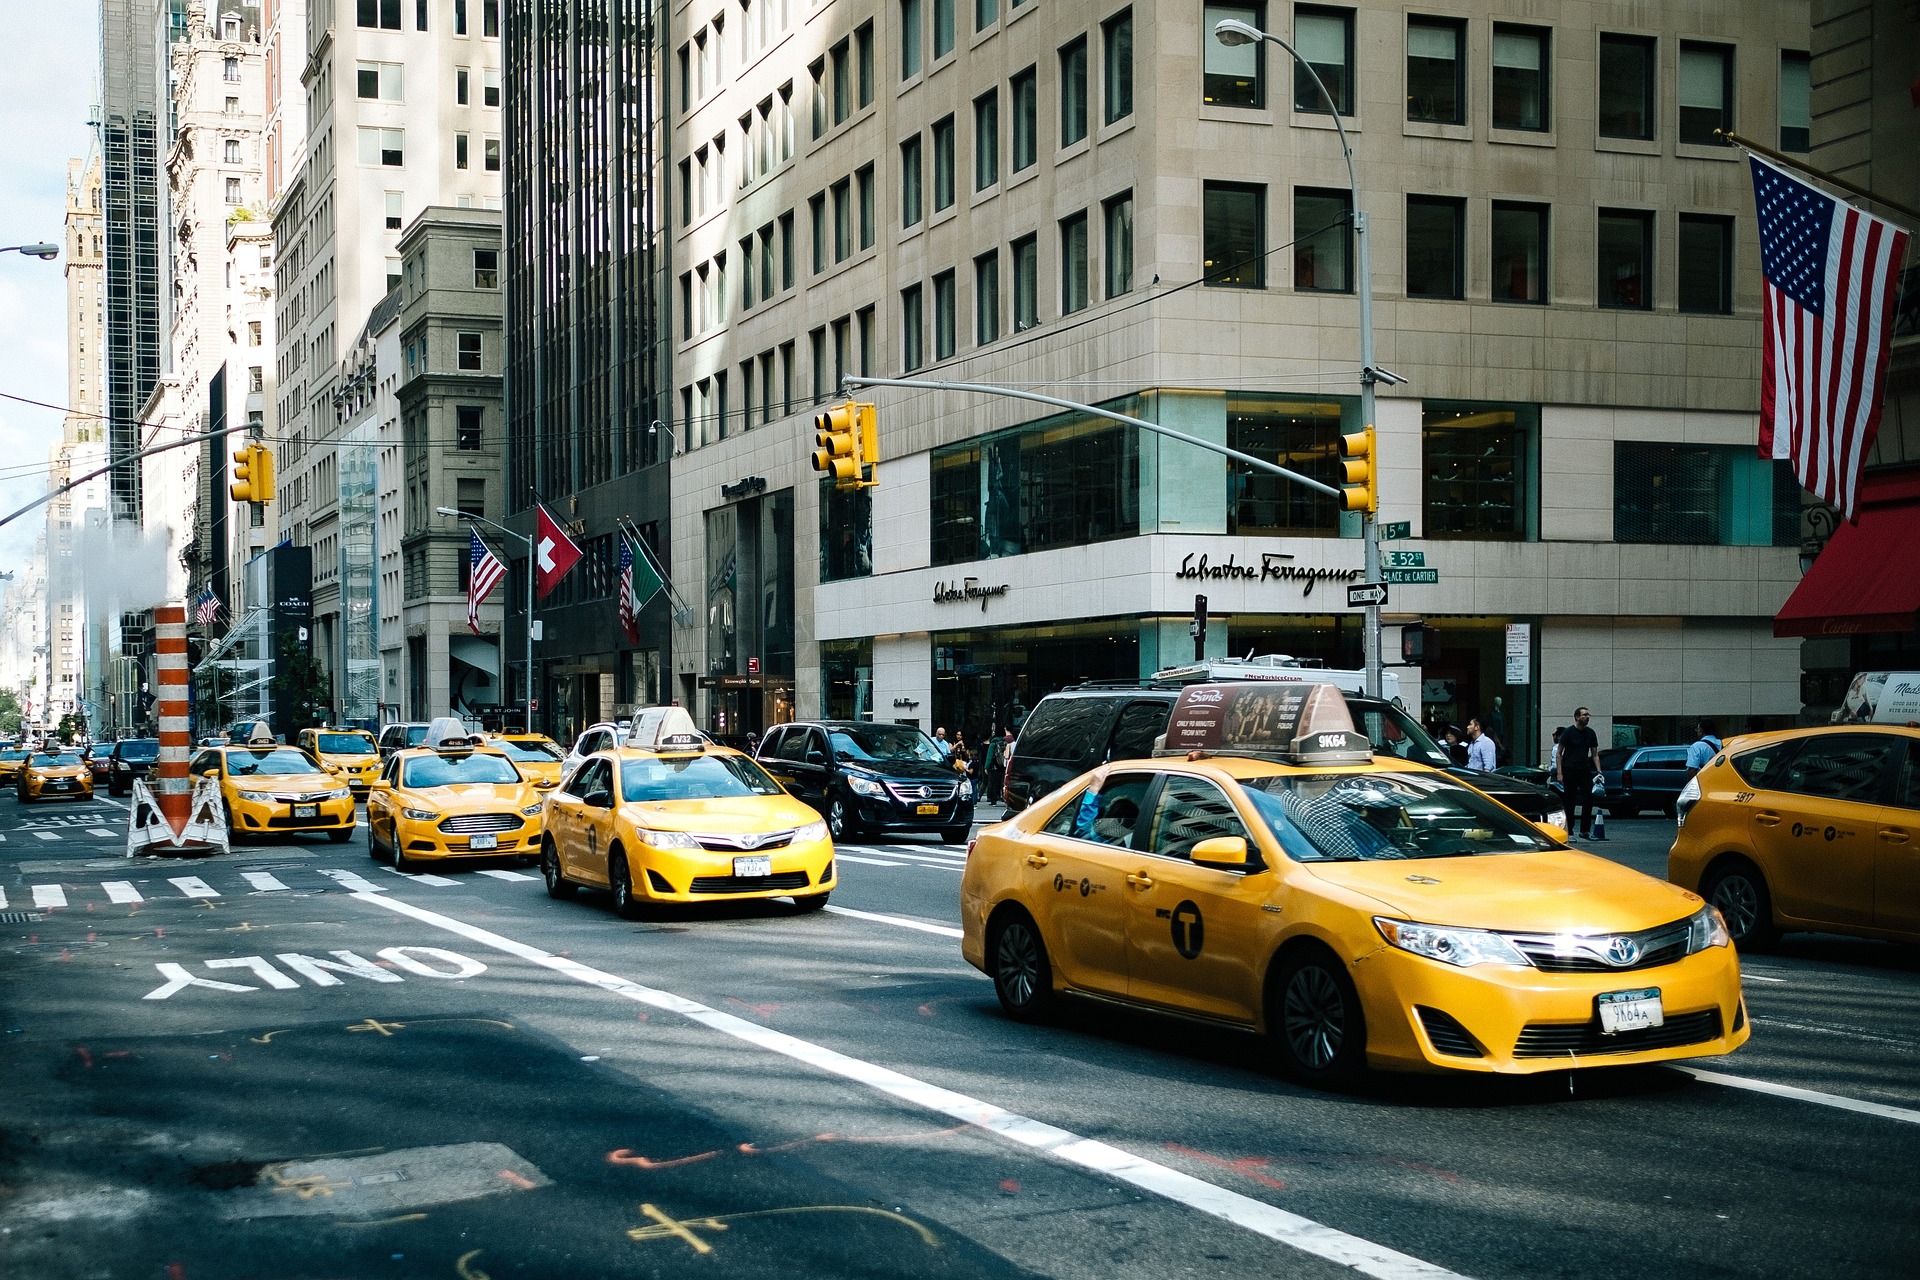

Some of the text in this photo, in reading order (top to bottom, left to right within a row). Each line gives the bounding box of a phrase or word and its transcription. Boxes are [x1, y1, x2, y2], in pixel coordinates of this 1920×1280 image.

[1389, 523, 1404, 539] 5 AV
[1390, 552, 1422, 566] E 52 ST
[1175, 552, 1366, 598] Salvatore Ferragamo
[1383, 571, 1402, 581] PLACE
[1412, 571, 1436, 582] CARTIER
[963, 577, 1009, 612] Ferragamo
[1352, 589, 1382, 601] ONE WAY
[1822, 619, 1860, 634] Cartier
[1187, 689, 1224, 703] Sands
[672, 735, 691, 743] 7V32
[1318, 734, 1346, 748] 9K64
[142, 946, 488, 1000] ONLY
